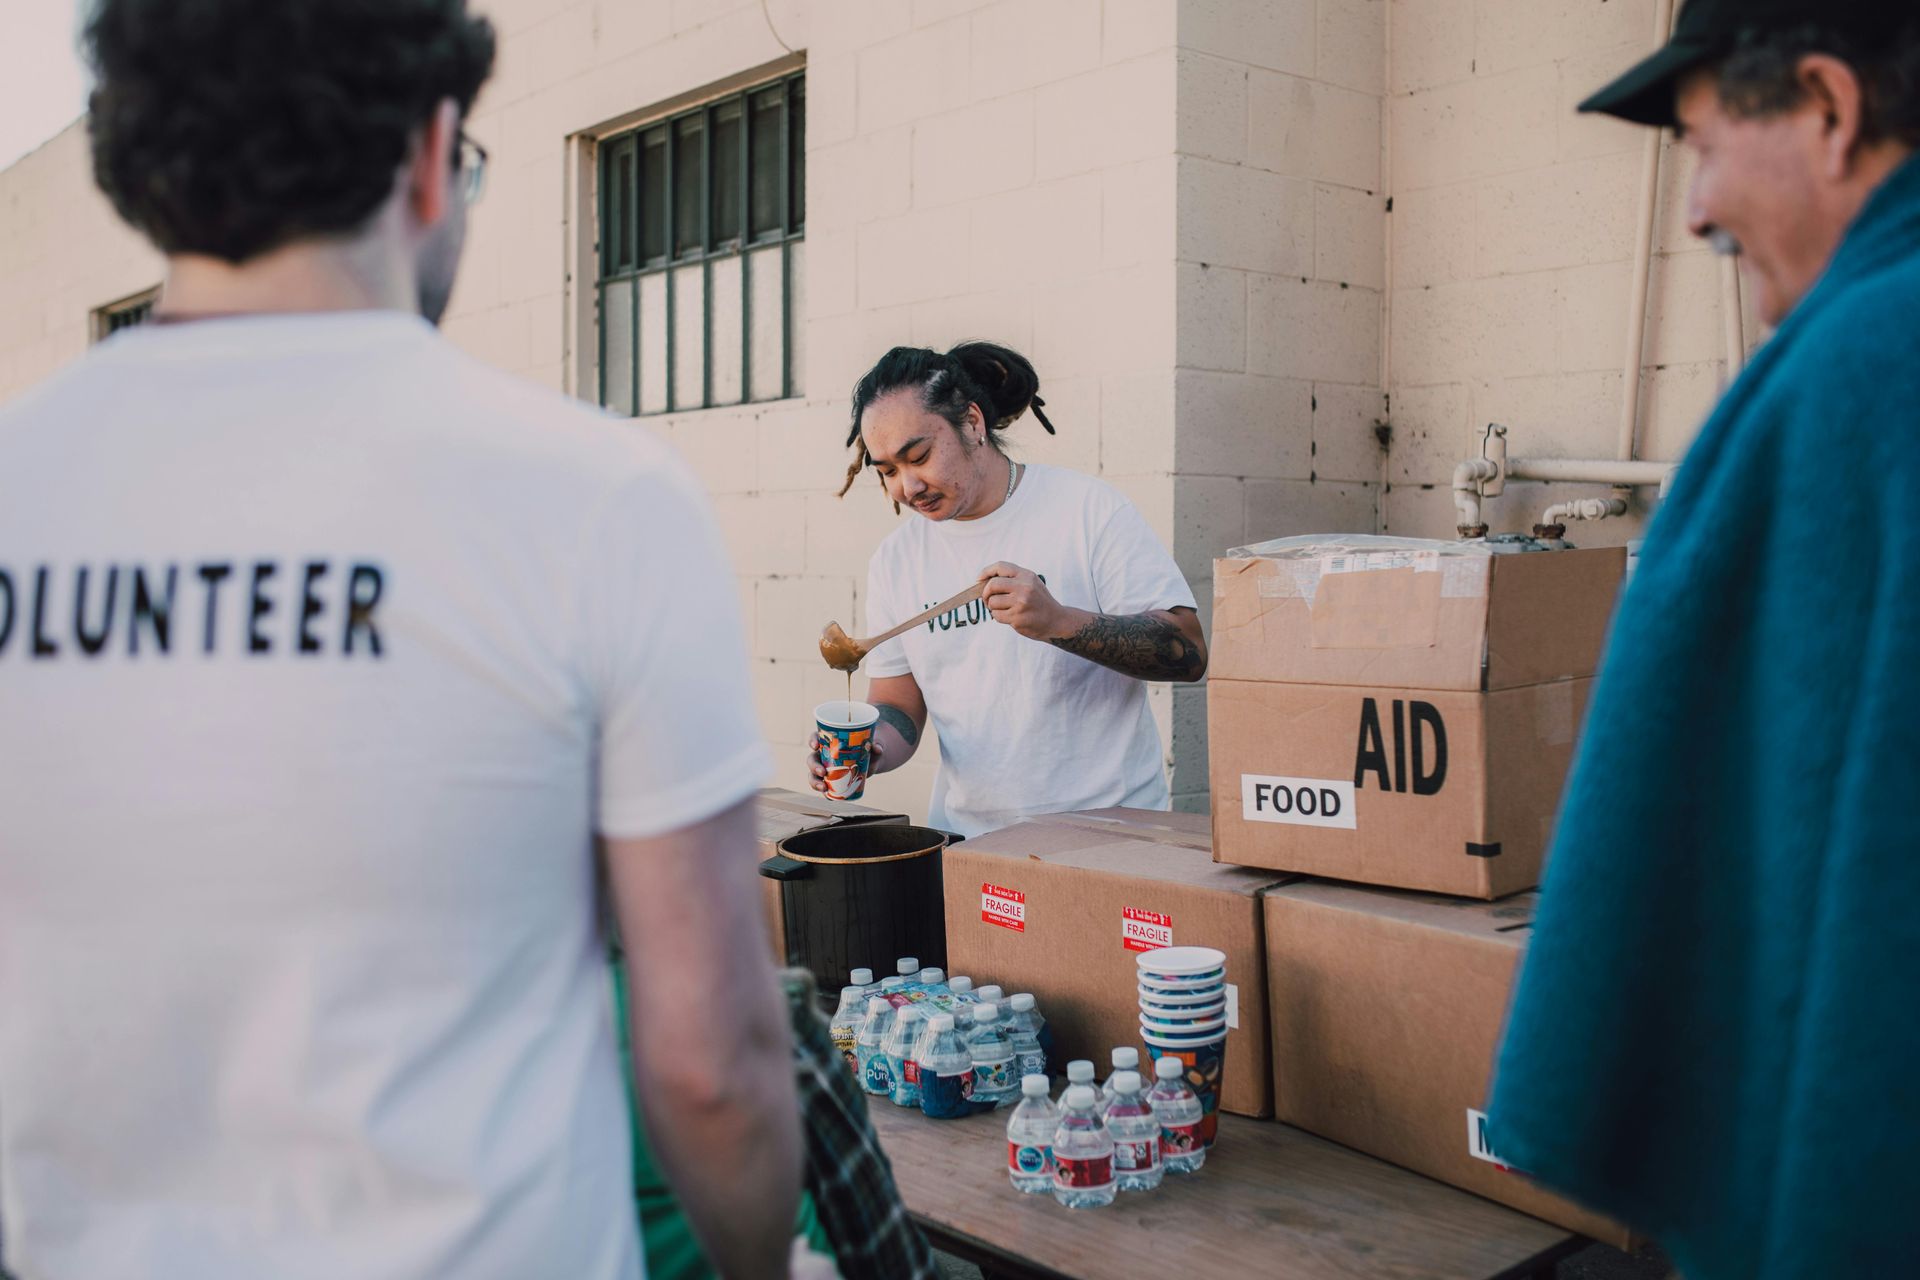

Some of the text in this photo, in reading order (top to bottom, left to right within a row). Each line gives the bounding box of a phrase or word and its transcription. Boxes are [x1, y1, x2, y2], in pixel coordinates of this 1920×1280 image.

[1354, 697, 1448, 796] AID
[1255, 783, 1341, 818] FOOD
[986, 898, 1021, 917] FRAGILE
[1127, 923, 1168, 942] FRAGILE
